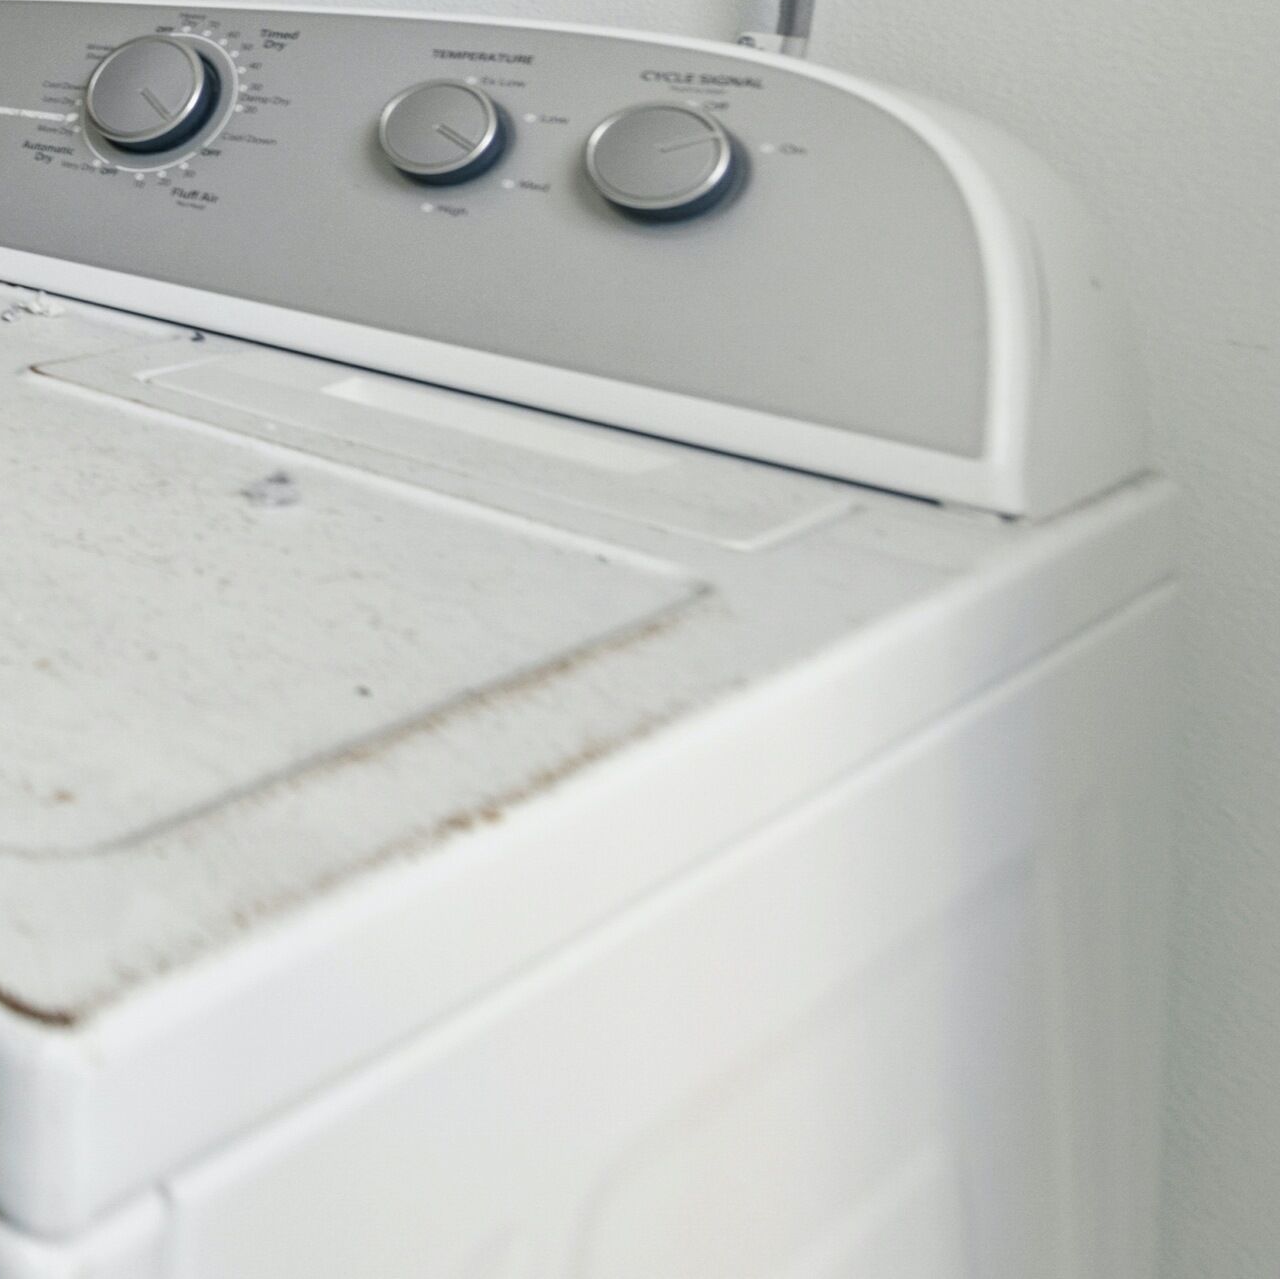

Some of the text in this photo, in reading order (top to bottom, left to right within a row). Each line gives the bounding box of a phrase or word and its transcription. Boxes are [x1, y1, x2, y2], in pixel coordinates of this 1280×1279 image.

[260, 28, 301, 41] Timed
[262, 39, 287, 51] Dry
[431, 48, 536, 65] TEMPERATURE
[639, 68, 693, 84] CYCLE
[698, 72, 764, 90] SIGNAL
[22, 140, 75, 156] Automatic
[33, 151, 54, 165] Dry
[171, 186, 219, 205] Fluff Air
